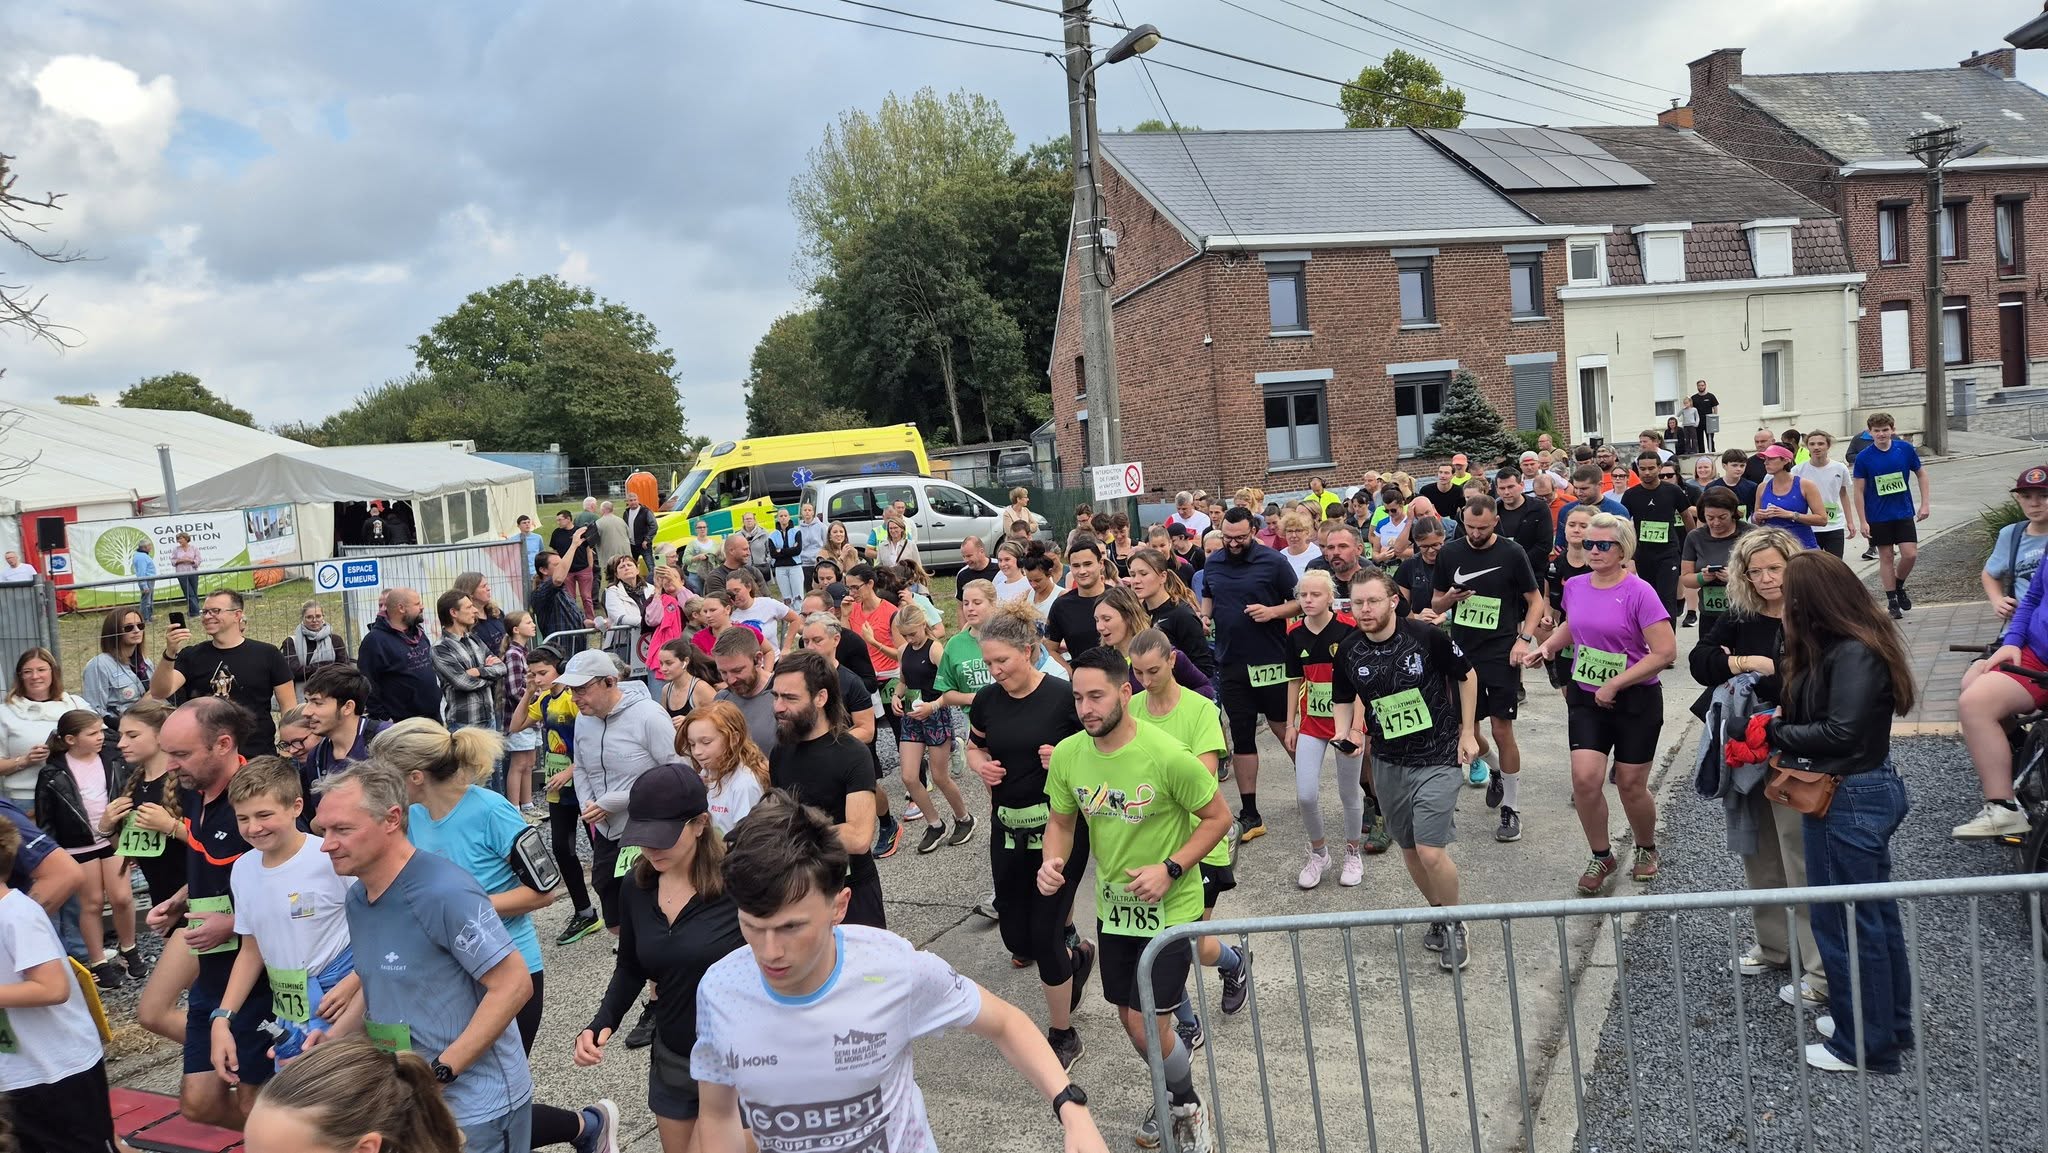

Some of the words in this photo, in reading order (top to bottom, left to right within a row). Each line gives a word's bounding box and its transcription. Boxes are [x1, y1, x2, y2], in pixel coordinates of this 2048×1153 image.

[1880, 480, 1904, 492] 4680
[154, 522, 214, 535] GARDEN
[1642, 530, 1664, 540] 4774
[159, 532, 220, 544] CRTION
[347, 564, 373, 574] ESPACE
[344, 574, 376, 584] FUMEURS
[1460, 608, 1495, 626] 4716
[1252, 666, 1282, 682] 4727
[1310, 698, 1333, 713] 466
[1383, 698, 1421, 713] ULTRATIMING
[1384, 707, 1424, 733] 4751
[1008, 814, 1048, 825] ULTRATIMING
[122, 832, 161, 851] 4734
[1109, 905, 1160, 931] 4785
[851, 1040, 886, 1055] MARATHON
[742, 1055, 778, 1068] MONS
[834, 1056, 843, 1064] DE
[844, 1056, 862, 1064] MONS
[752, 1093, 877, 1132] GOBERT
[820, 1120, 881, 1146] GOBERT
